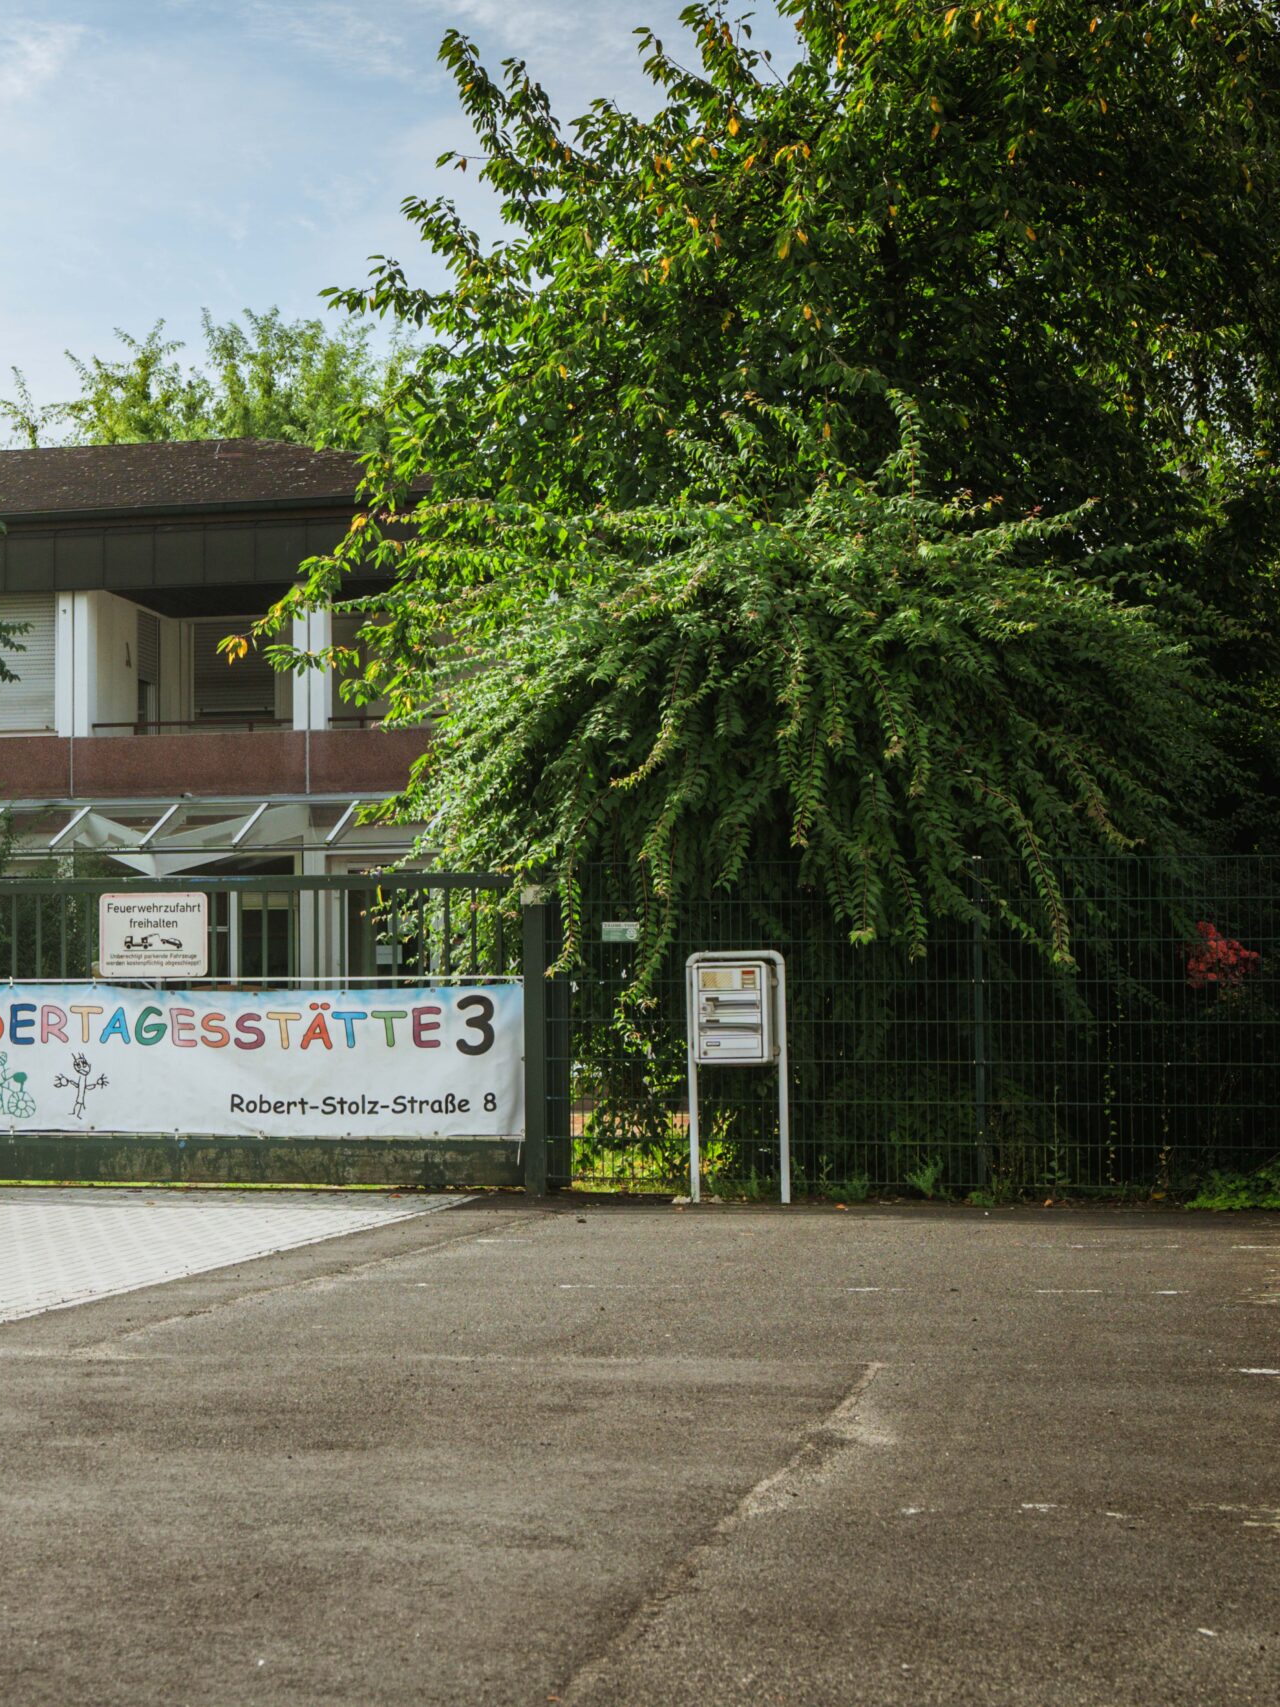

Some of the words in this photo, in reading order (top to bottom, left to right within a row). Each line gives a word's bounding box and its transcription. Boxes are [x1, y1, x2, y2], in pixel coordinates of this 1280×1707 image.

[107, 902, 201, 913] Feuerwehrzufahrt
[129, 918, 178, 929] freihalten
[455, 994, 495, 1056] 3
[230, 1092, 471, 1115] Robert-Stolz-Straße
[483, 1092, 498, 1112] 8
